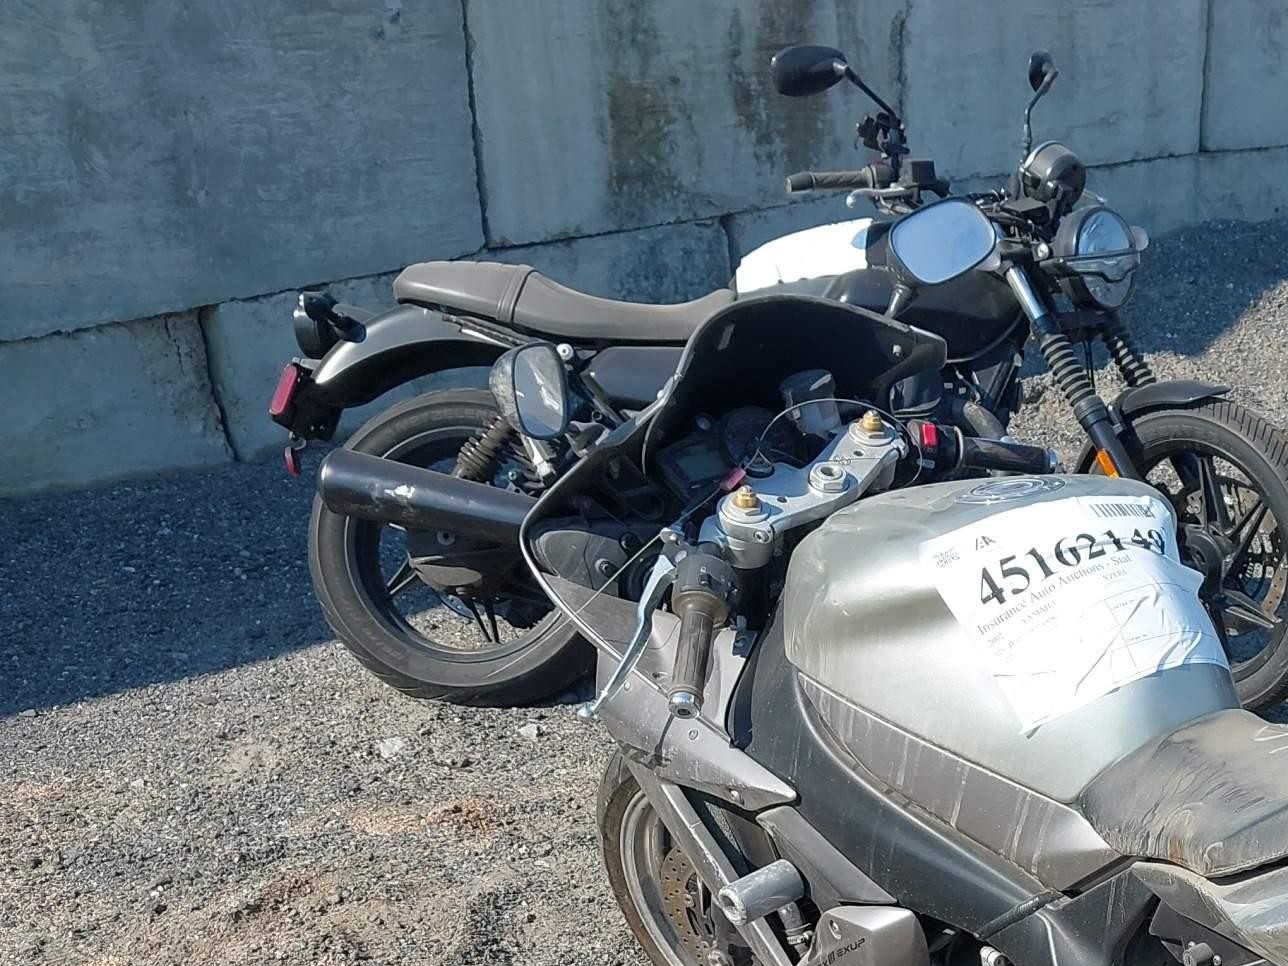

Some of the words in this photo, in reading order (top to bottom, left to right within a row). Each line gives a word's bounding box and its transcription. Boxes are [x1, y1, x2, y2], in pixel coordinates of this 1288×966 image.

[977, 599, 1028, 636] Insurance
[1029, 583, 1057, 604] Auto
[1057, 560, 1106, 588] Auctions
[980, 526, 1166, 605] 45162149
[836, 937, 866, 959] EXUP
